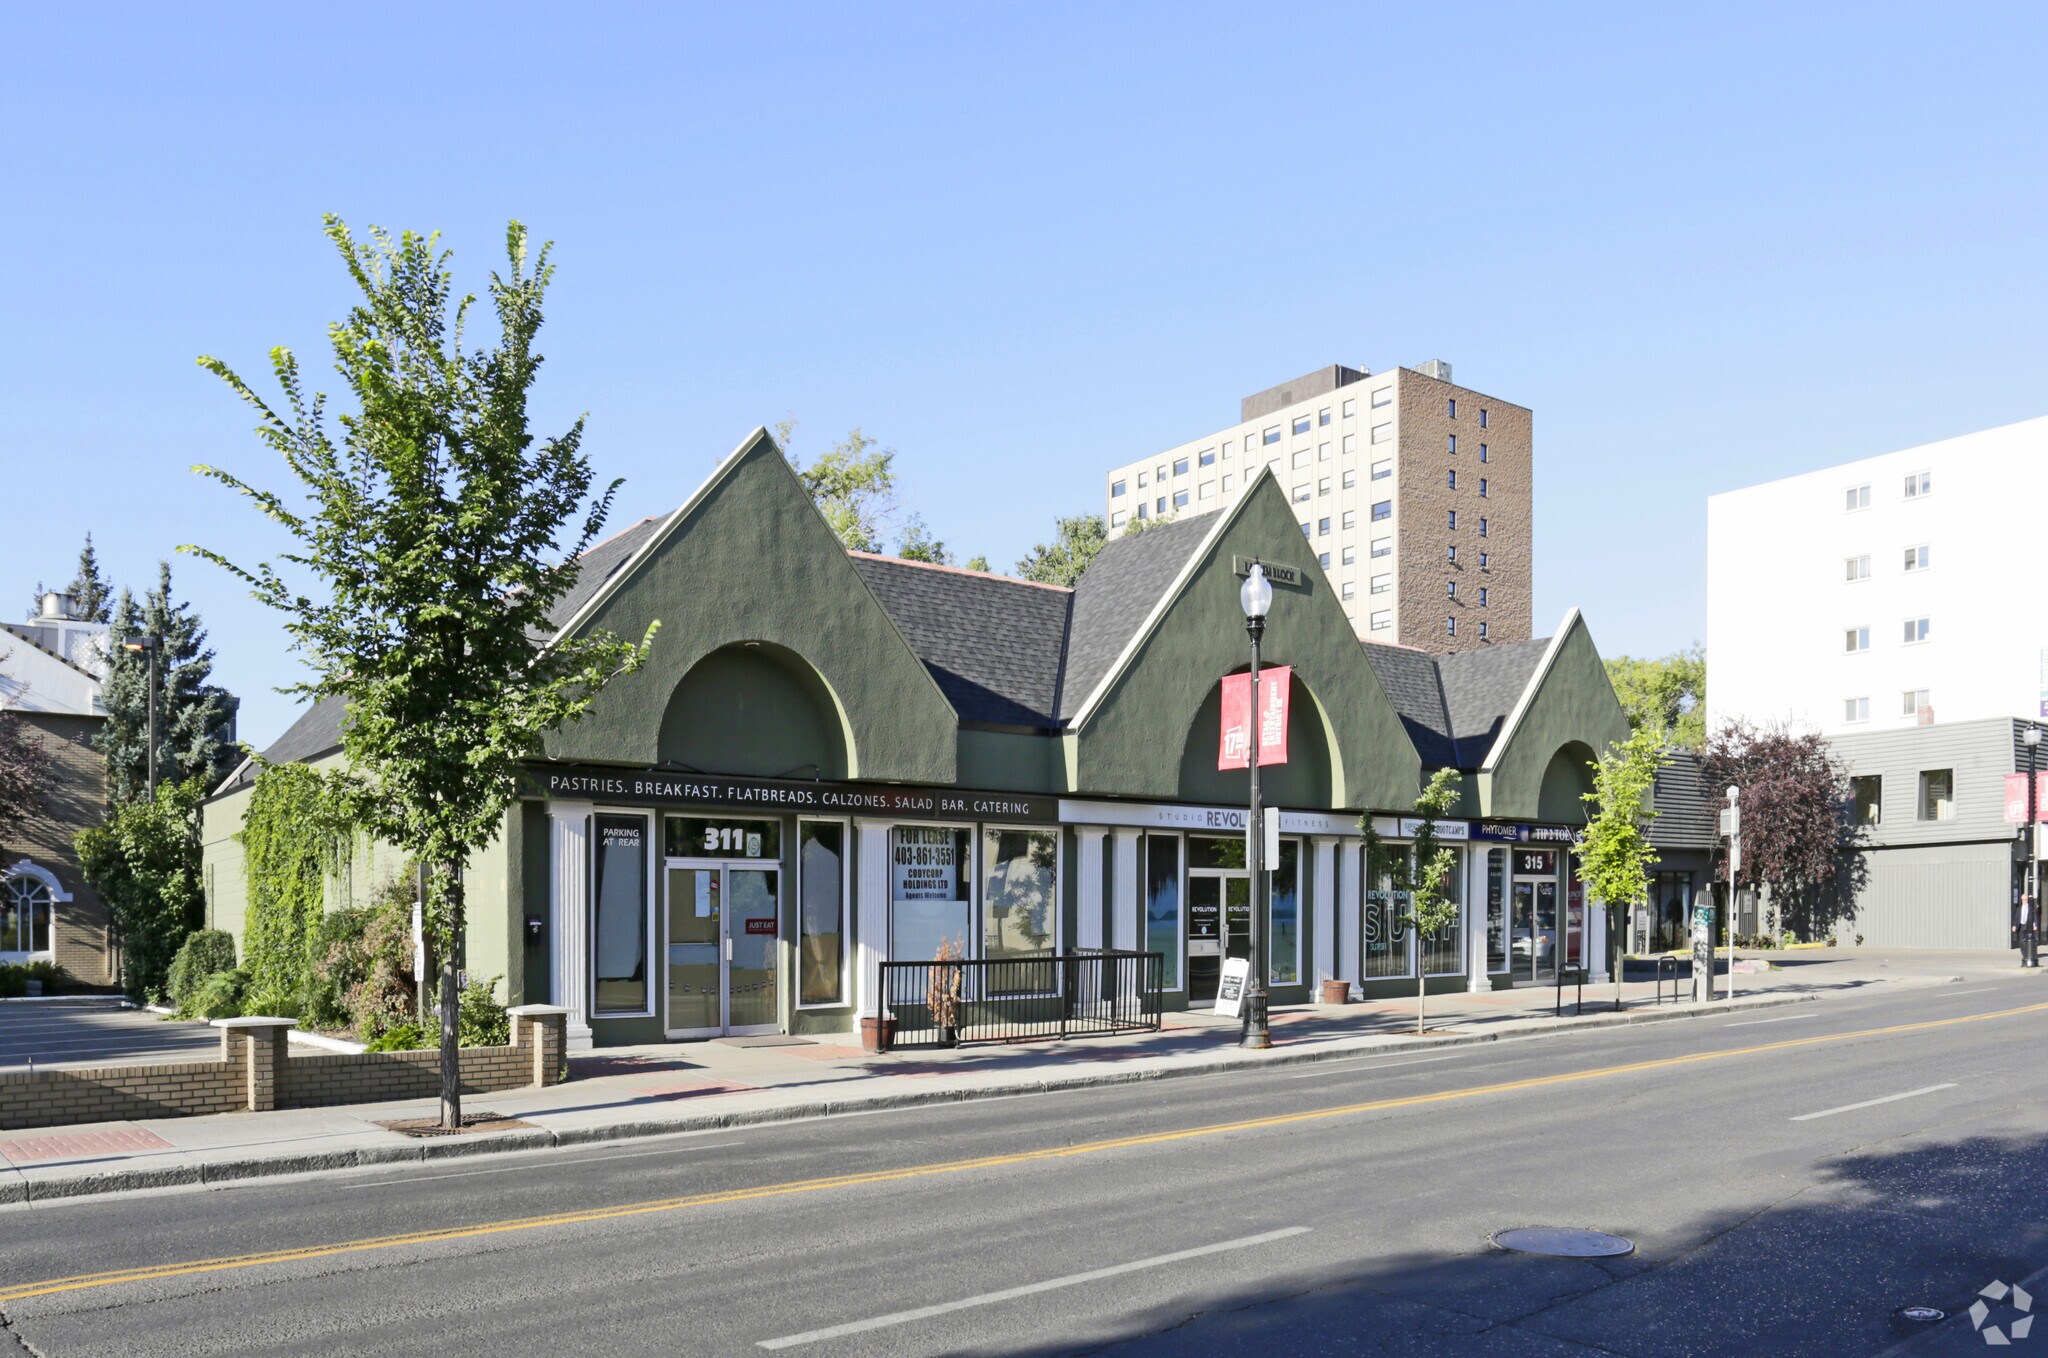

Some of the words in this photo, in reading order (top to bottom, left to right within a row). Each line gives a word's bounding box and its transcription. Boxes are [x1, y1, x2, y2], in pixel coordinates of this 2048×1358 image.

[1269, 681, 1277, 746] ENTERTAINMENT
[550, 776, 628, 793] PASTRIES.
[635, 781, 722, 798] BREAKFAST.
[728, 787, 817, 804] FLATBREADS.
[822, 792, 890, 808] CALZONES.
[895, 797, 933, 810] SALAD
[941, 799, 968, 811] BAR.
[973, 800, 1030, 815] CATERING
[1159, 812, 1203, 822] STUDIO
[1285, 819, 1329, 828] FITNESS
[603, 828, 640, 838] PARKING
[1481, 824, 1517, 836] PHYTOMER
[1535, 828, 1549, 841] TIP
[602, 837, 614, 847] AT
[618, 838, 640, 848] REAR
[704, 827, 744, 850] 311
[900, 829, 919, 845] FOR
[922, 829, 949, 845] LEASE
[895, 847, 955, 866] 403-861-3551
[1524, 855, 1543, 870] 315
[908, 868, 944, 878] CODYCORP
[903, 880, 937, 889] HOLDINGS
[938, 880, 948, 889] LTD
[905, 892, 923, 900] Agents
[1367, 890, 1408, 900] REVOLUTION
[748, 921, 762, 929] JUST
[763, 921, 775, 929] EAT
